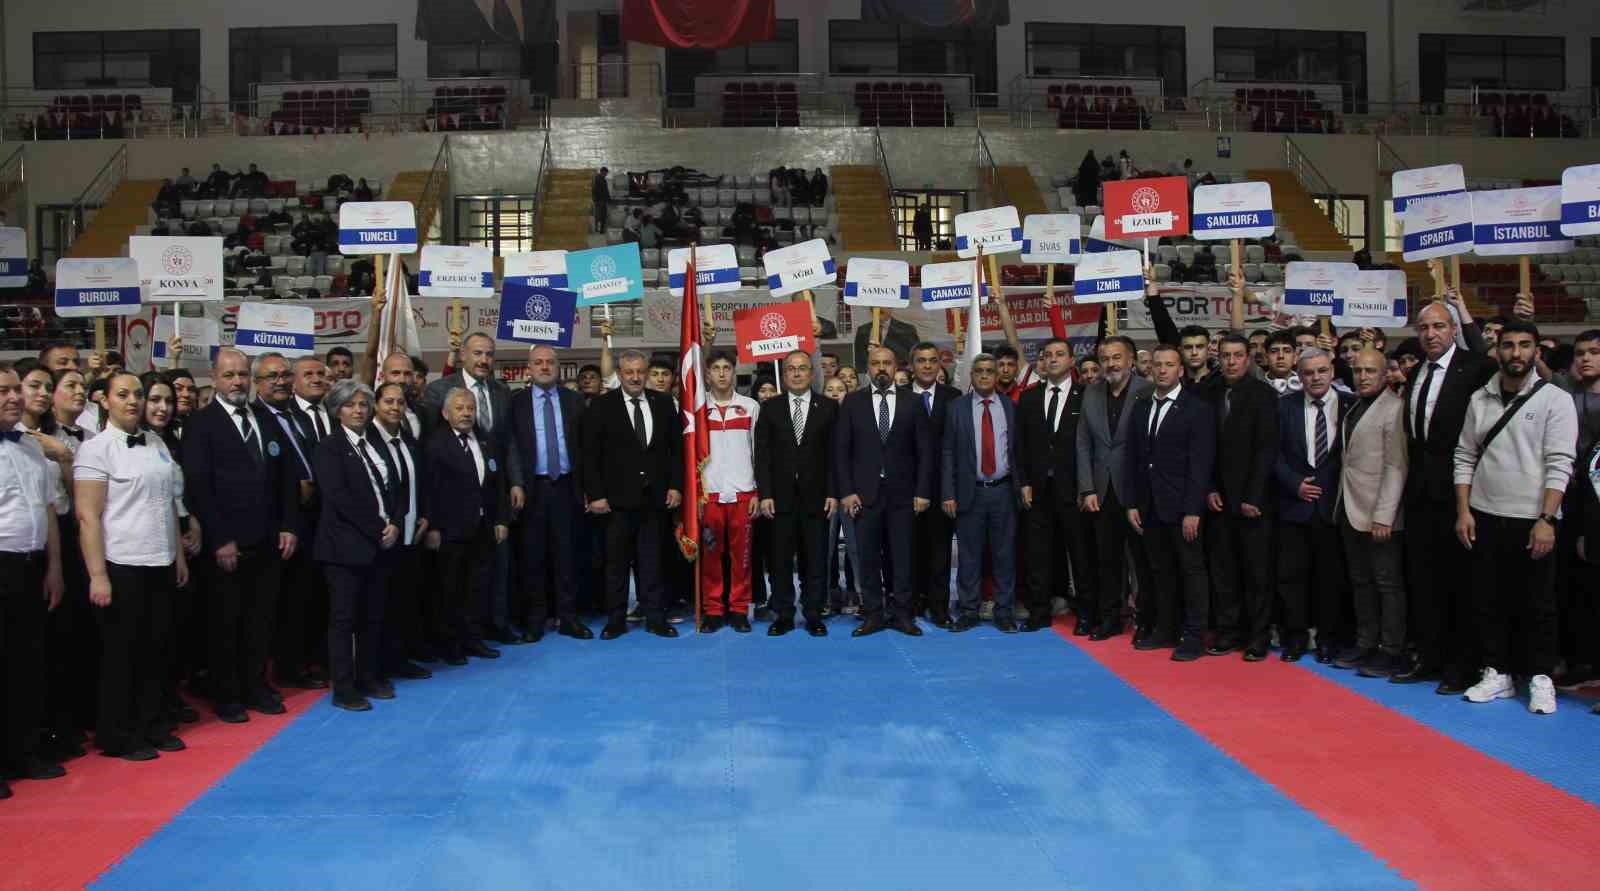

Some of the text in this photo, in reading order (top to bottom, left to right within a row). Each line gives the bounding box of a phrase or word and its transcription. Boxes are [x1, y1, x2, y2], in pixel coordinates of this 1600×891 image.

[1207, 214, 1259, 228] ŞANLIURFA
[359, 230, 397, 242] TUNCELİ
[1420, 230, 1455, 247] ISPARTA
[1494, 225, 1551, 240] İSTANBUL
[159, 279, 200, 289] KONYA
[1096, 279, 1121, 292] İZMİR
[79, 291, 120, 303] BURDUR
[861, 286, 897, 297] SAMSUN
[519, 325, 554, 335] MERSİN
[253, 332, 296, 346] KÜTAHYA
